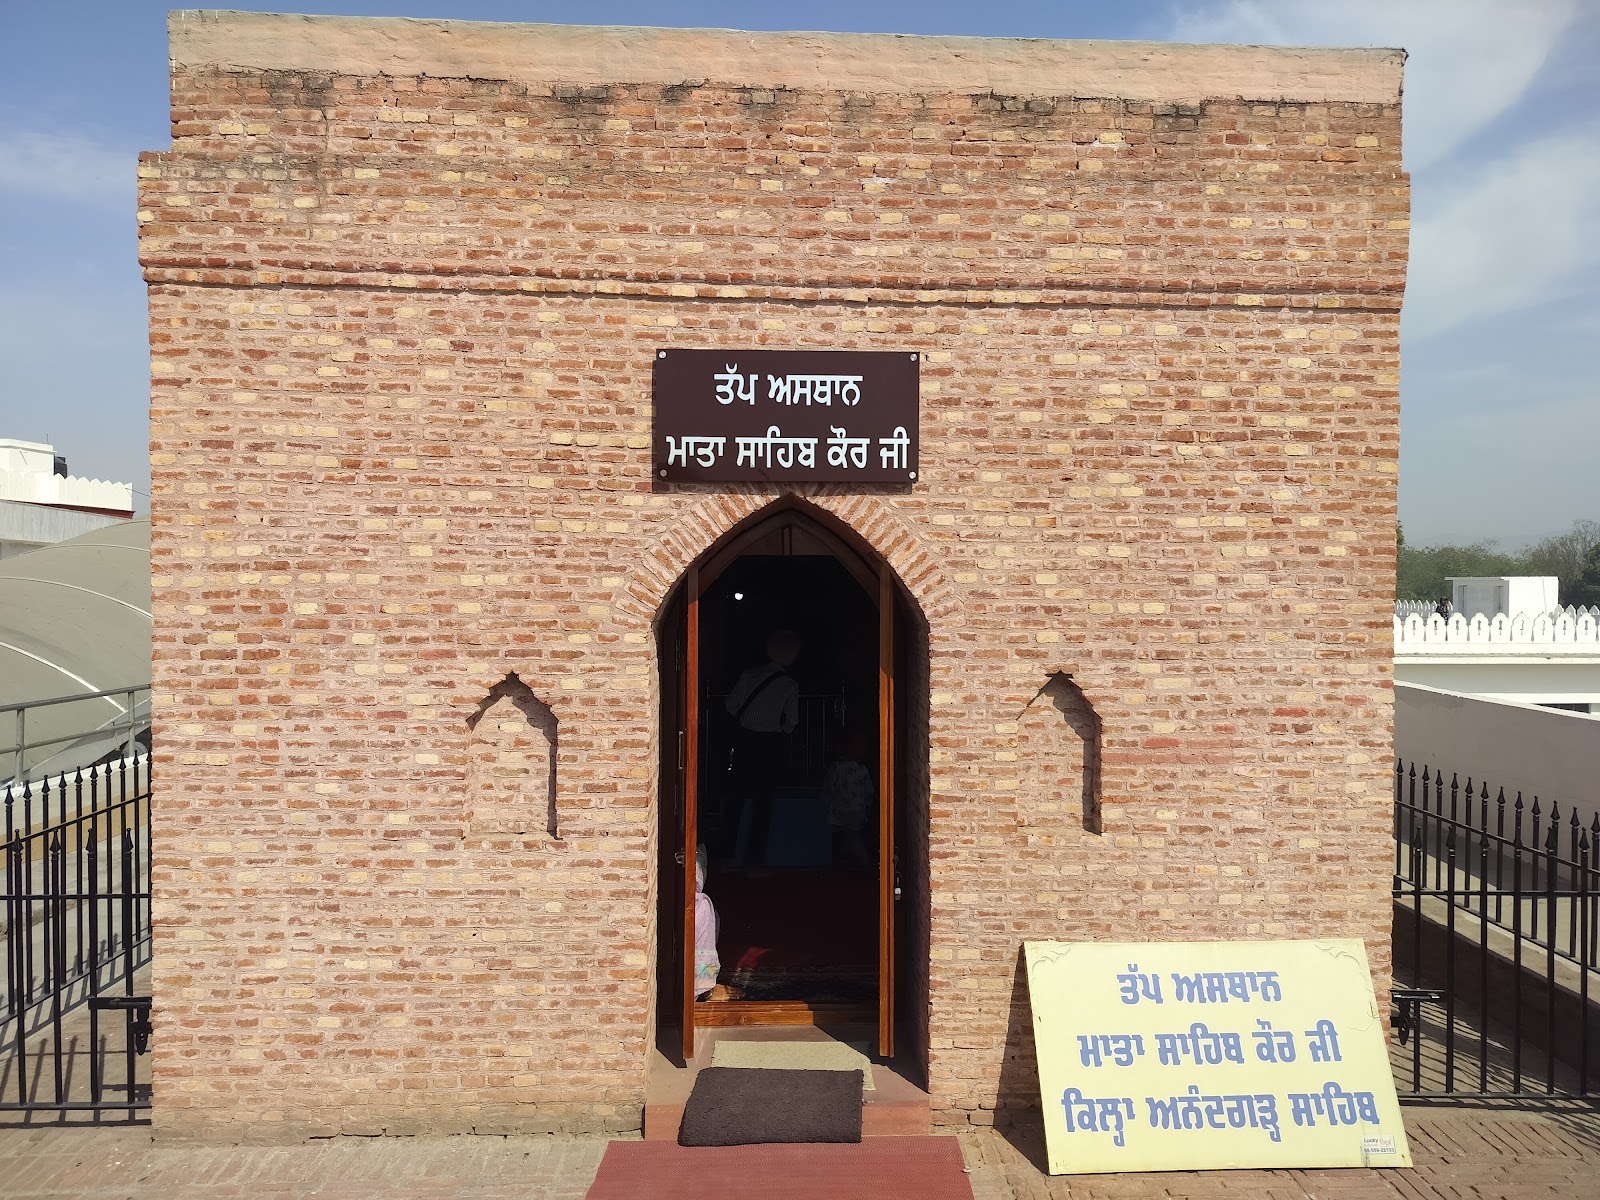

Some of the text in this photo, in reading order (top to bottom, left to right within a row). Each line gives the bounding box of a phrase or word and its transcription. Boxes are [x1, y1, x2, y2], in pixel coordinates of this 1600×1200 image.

[713, 363, 864, 407] ਤੱਪ ਅਸਥਾਨ
[665, 424, 911, 469] ਮਾਤਾ ਸਾਹਿਬ ਕੌਰ ਜੀ
[1116, 963, 1283, 1006] ਤੱਪ ਅਸਥਾਨ
[1076, 1018, 1343, 1069] ਮਾਤਾ ਸਾਹਿਬ ਕੌਰ ਜੀ
[1060, 1081, 1381, 1147] ਕਿਲ੍ਹਾ ਅਨੰਦਗੜ੍ਹ ਸਾਹਿਬ
